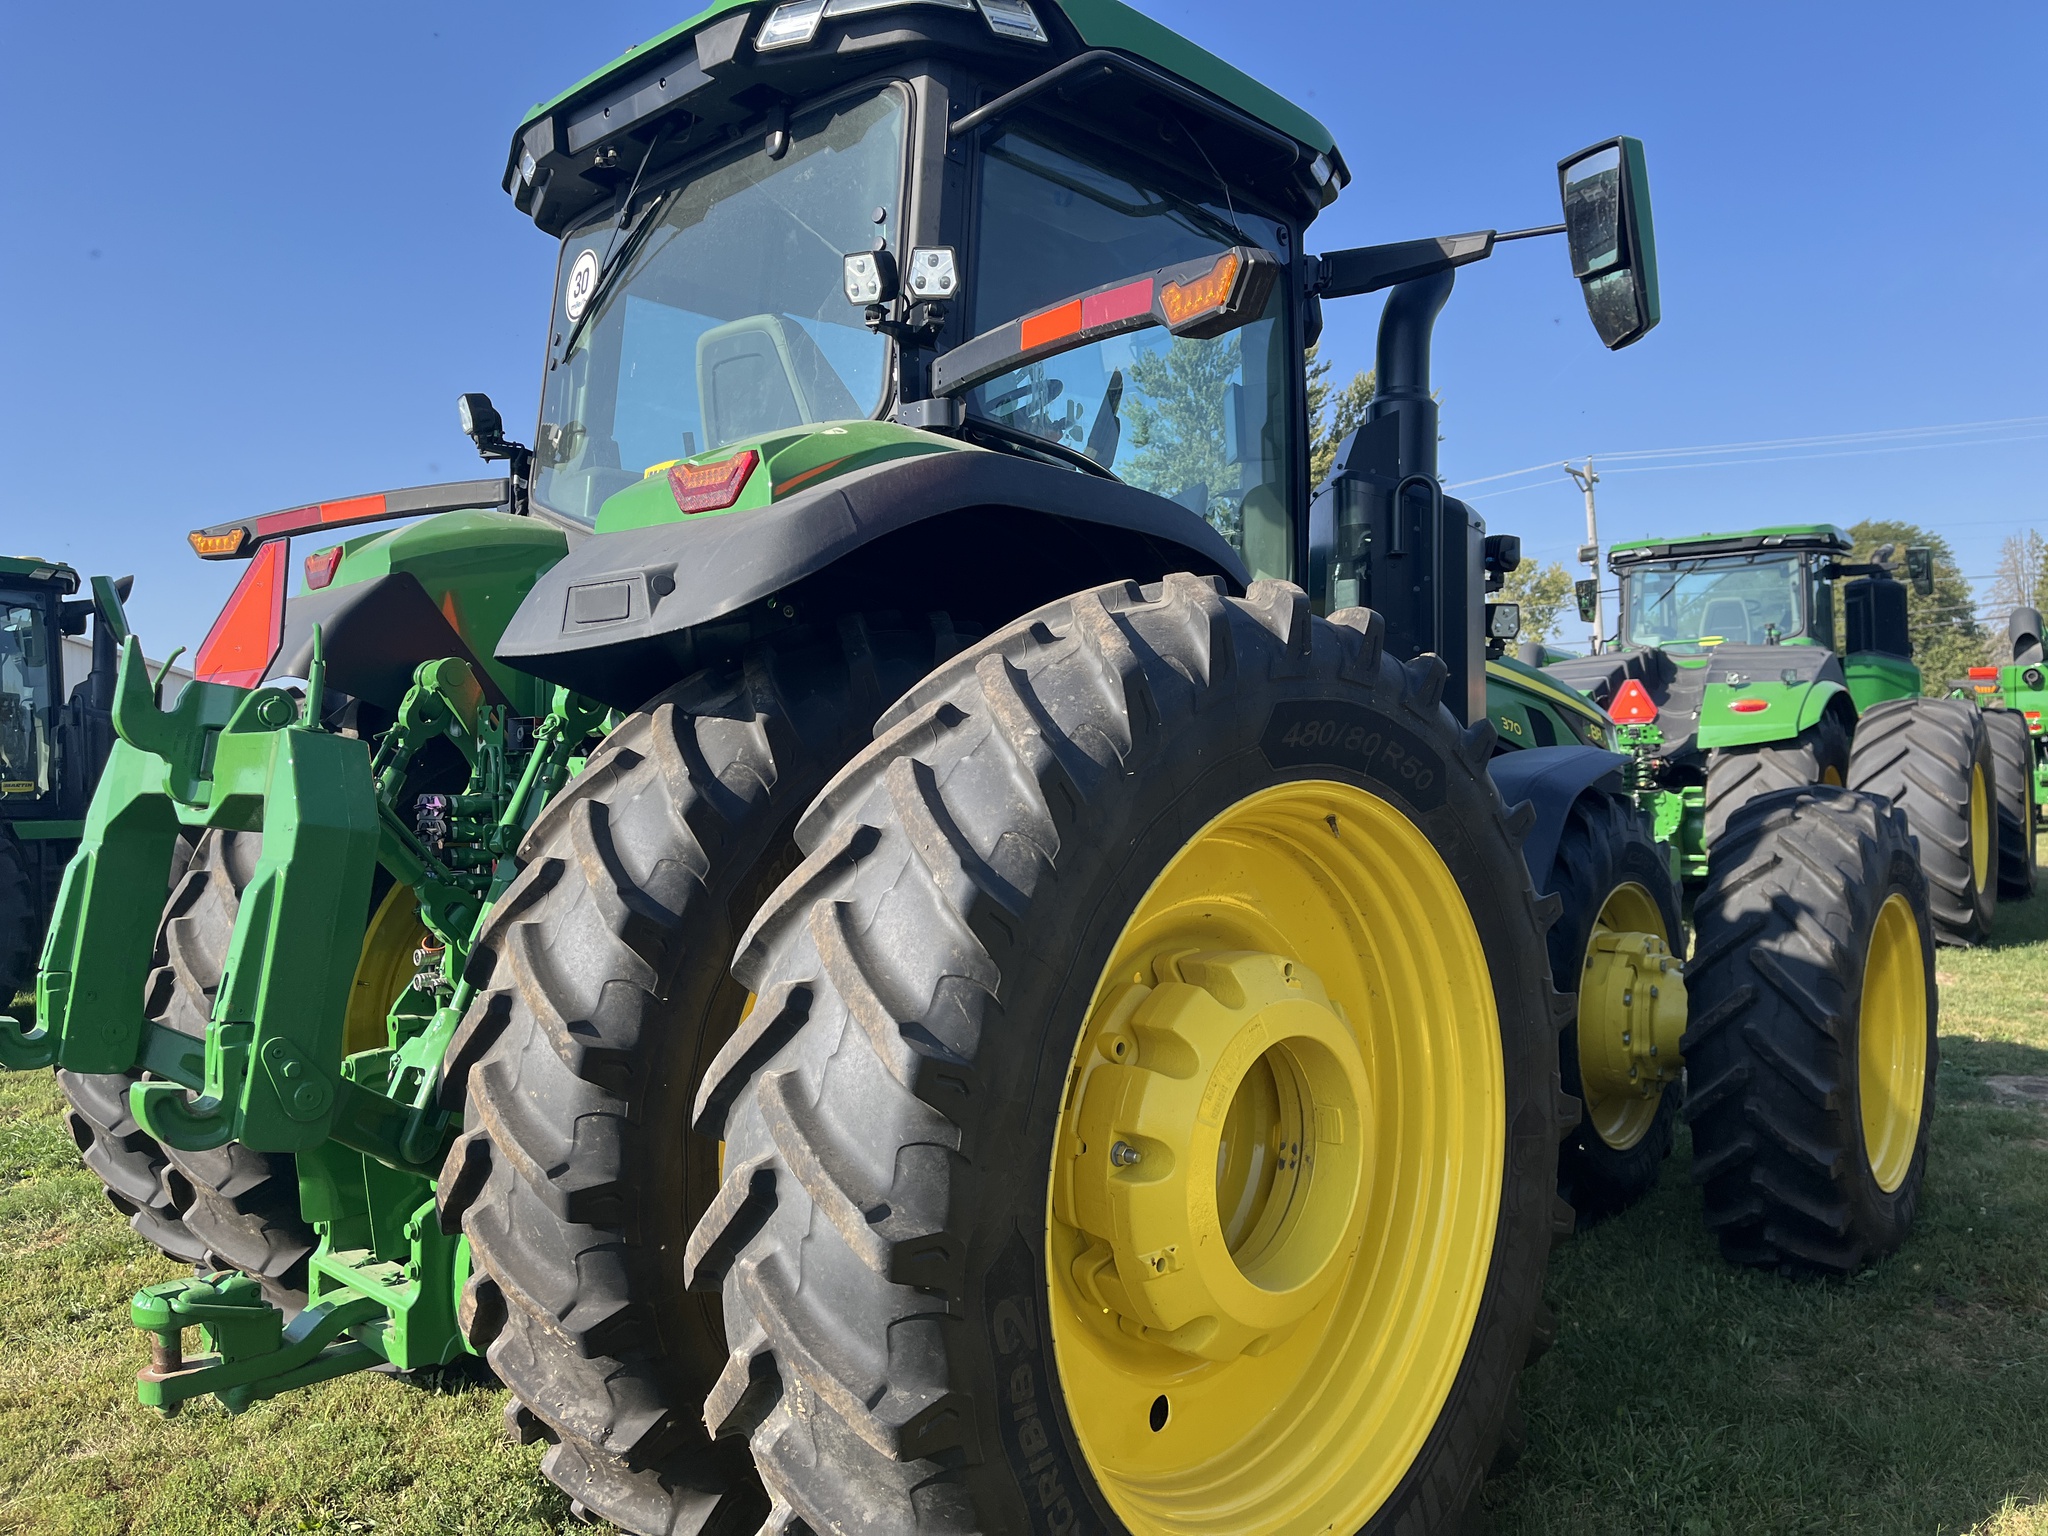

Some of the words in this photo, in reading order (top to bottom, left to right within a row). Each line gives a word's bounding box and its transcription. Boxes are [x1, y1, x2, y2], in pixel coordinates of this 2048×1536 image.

[574, 267, 590, 299] 30
[1500, 716, 1523, 737] 370
[1590, 723, 1604, 742] 8R
[1282, 720, 1382, 757] 480/80
[1381, 741, 1435, 791] R50
[993, 1296, 1039, 1355] 2
[1010, 1364, 1081, 1536] GRIBIB
